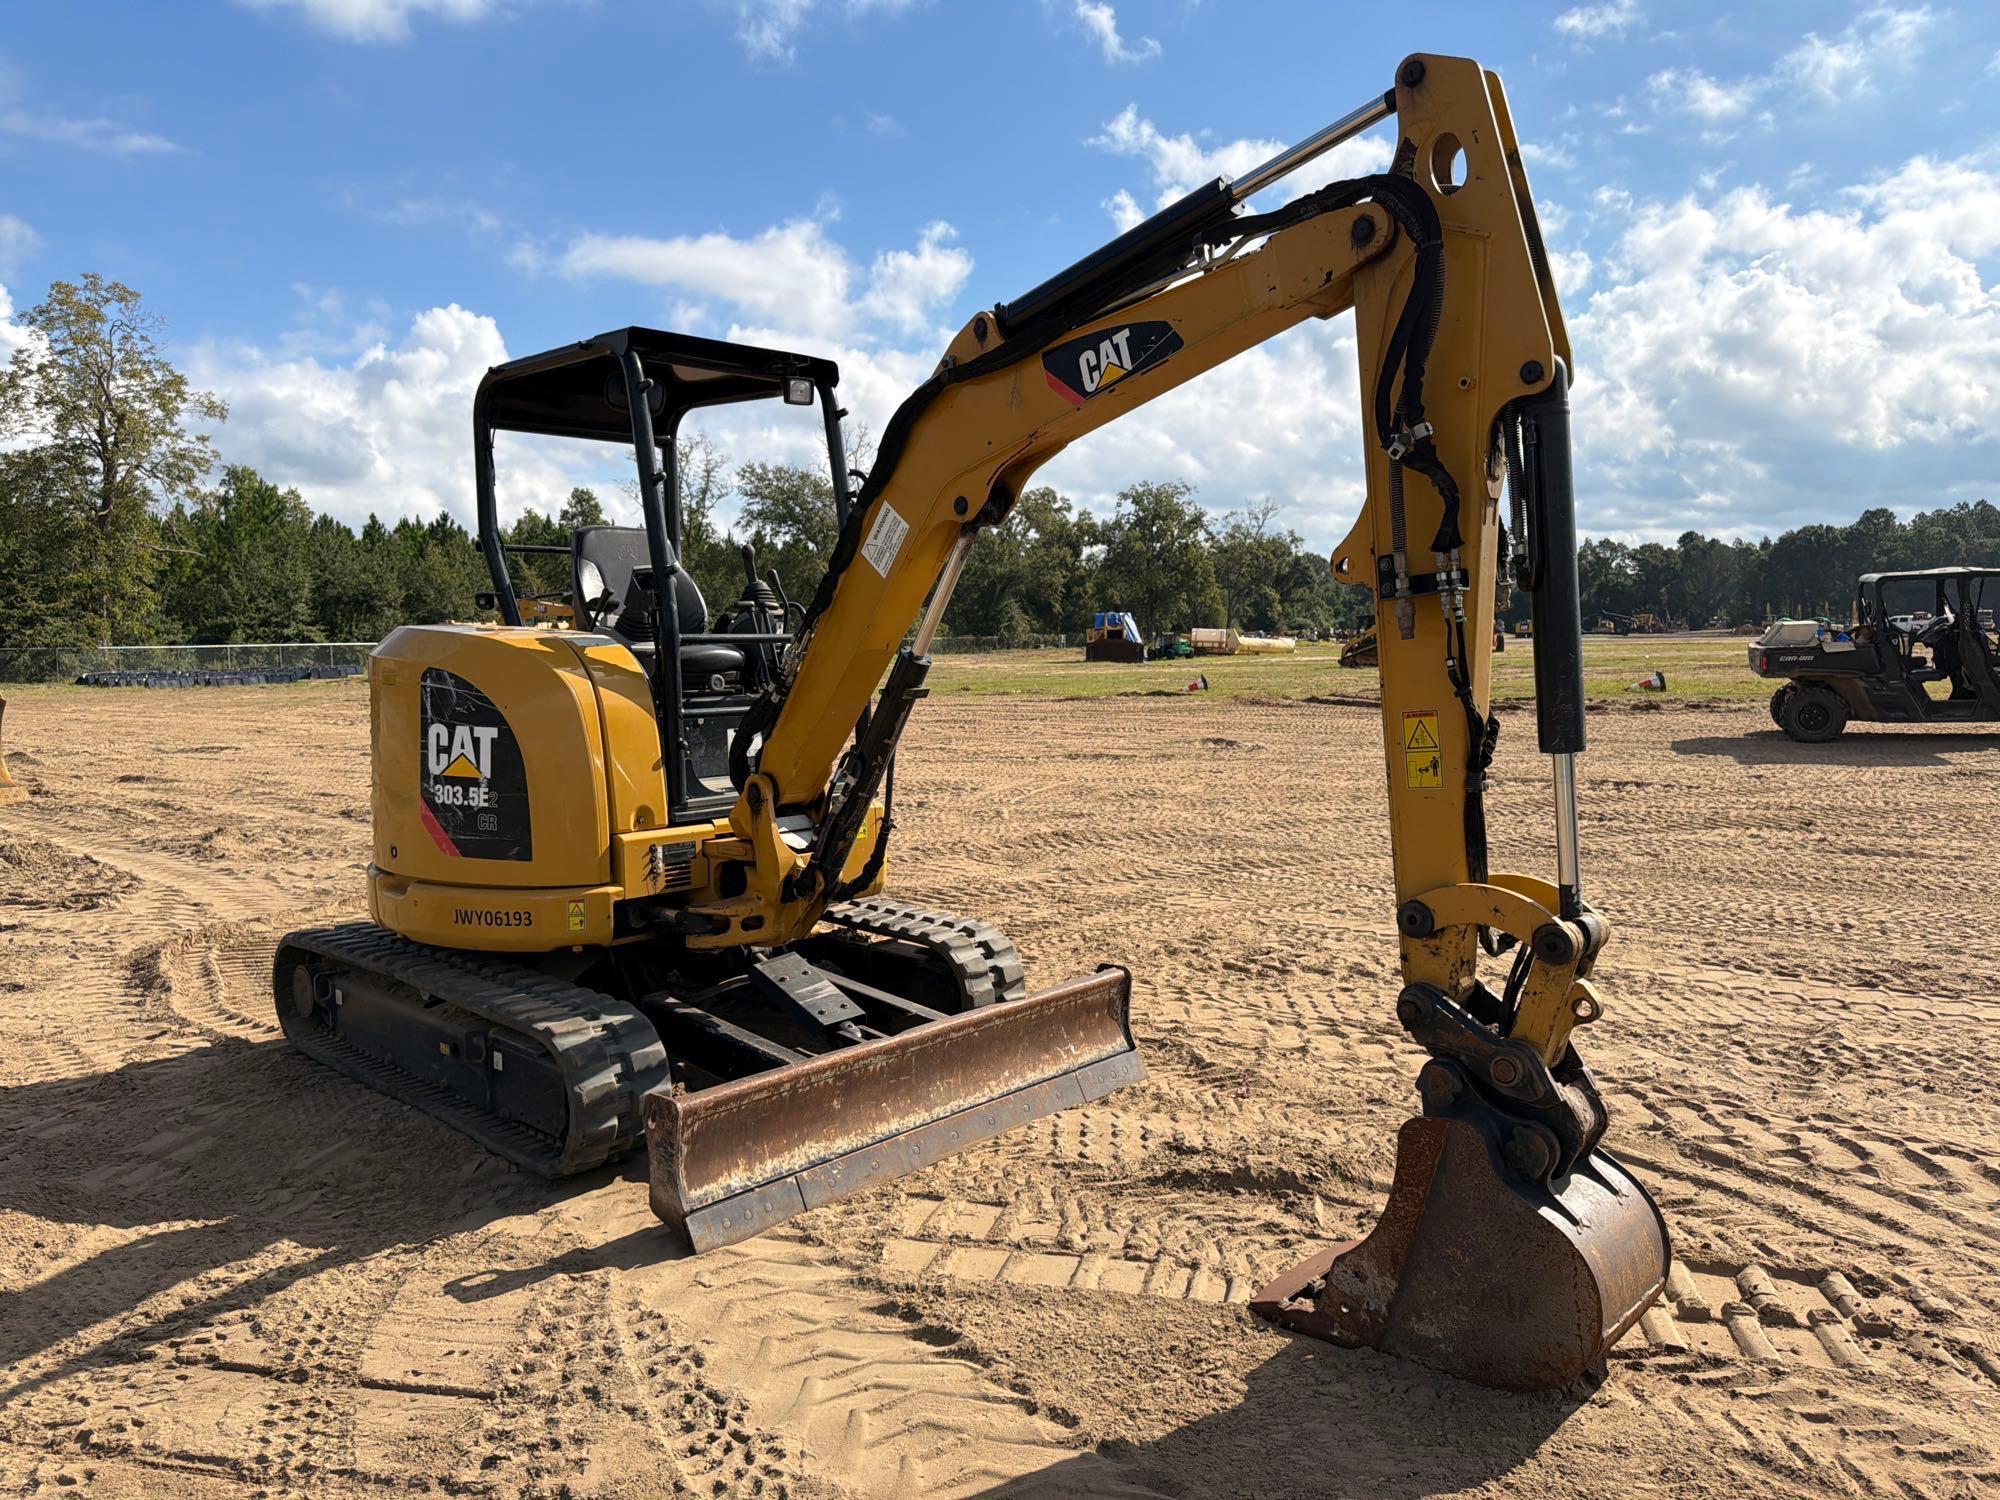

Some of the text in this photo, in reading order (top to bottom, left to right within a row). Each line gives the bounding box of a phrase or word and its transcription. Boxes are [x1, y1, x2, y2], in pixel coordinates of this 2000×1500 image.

[1079, 327, 1133, 393] CAT
[873, 507, 891, 541] WARNING
[427, 722, 499, 779] CAT
[477, 813, 498, 831] CR
[454, 909, 533, 927] JWY06193
